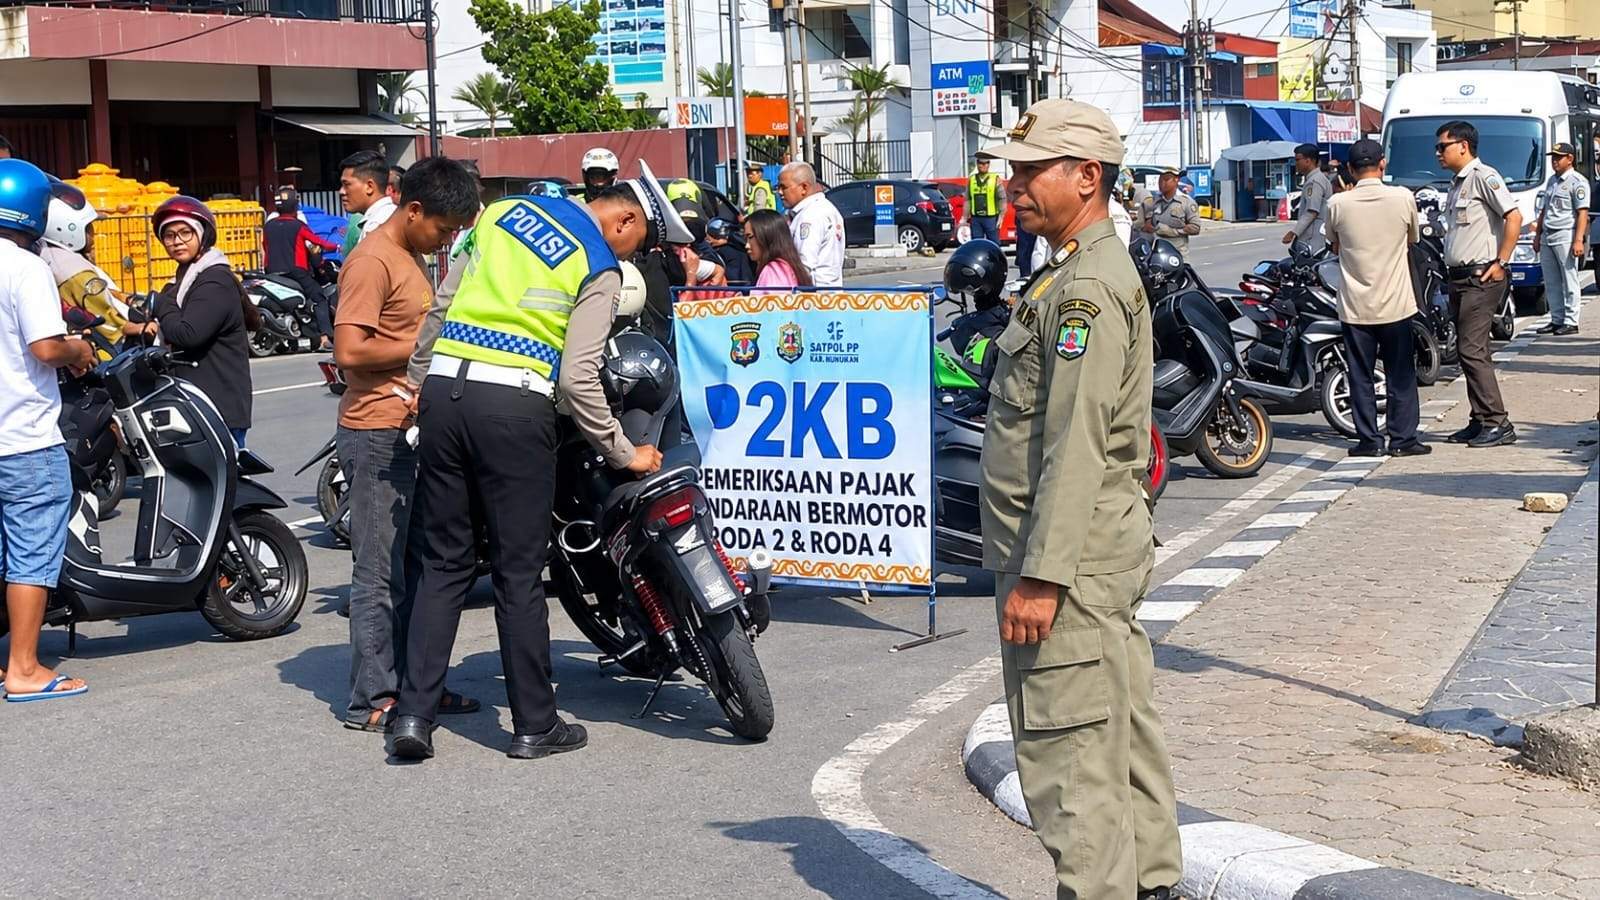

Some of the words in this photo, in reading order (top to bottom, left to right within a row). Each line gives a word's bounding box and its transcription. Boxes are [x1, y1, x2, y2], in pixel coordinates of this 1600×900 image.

[937, 0, 976, 16] BNI
[938, 68, 963, 80] ATM
[691, 103, 712, 125] BNI
[502, 206, 571, 262] POLISI
[810, 342, 844, 353] SATPOL
[847, 342, 859, 353] PP
[840, 471, 916, 497] PAJAK
[709, 498, 801, 523] NDARAAN
[808, 502, 927, 528] BERMOTOR
[772, 528, 785, 551] 2
[791, 530, 805, 552] &
[810, 530, 874, 556] RODA
[878, 534, 892, 557] 4
